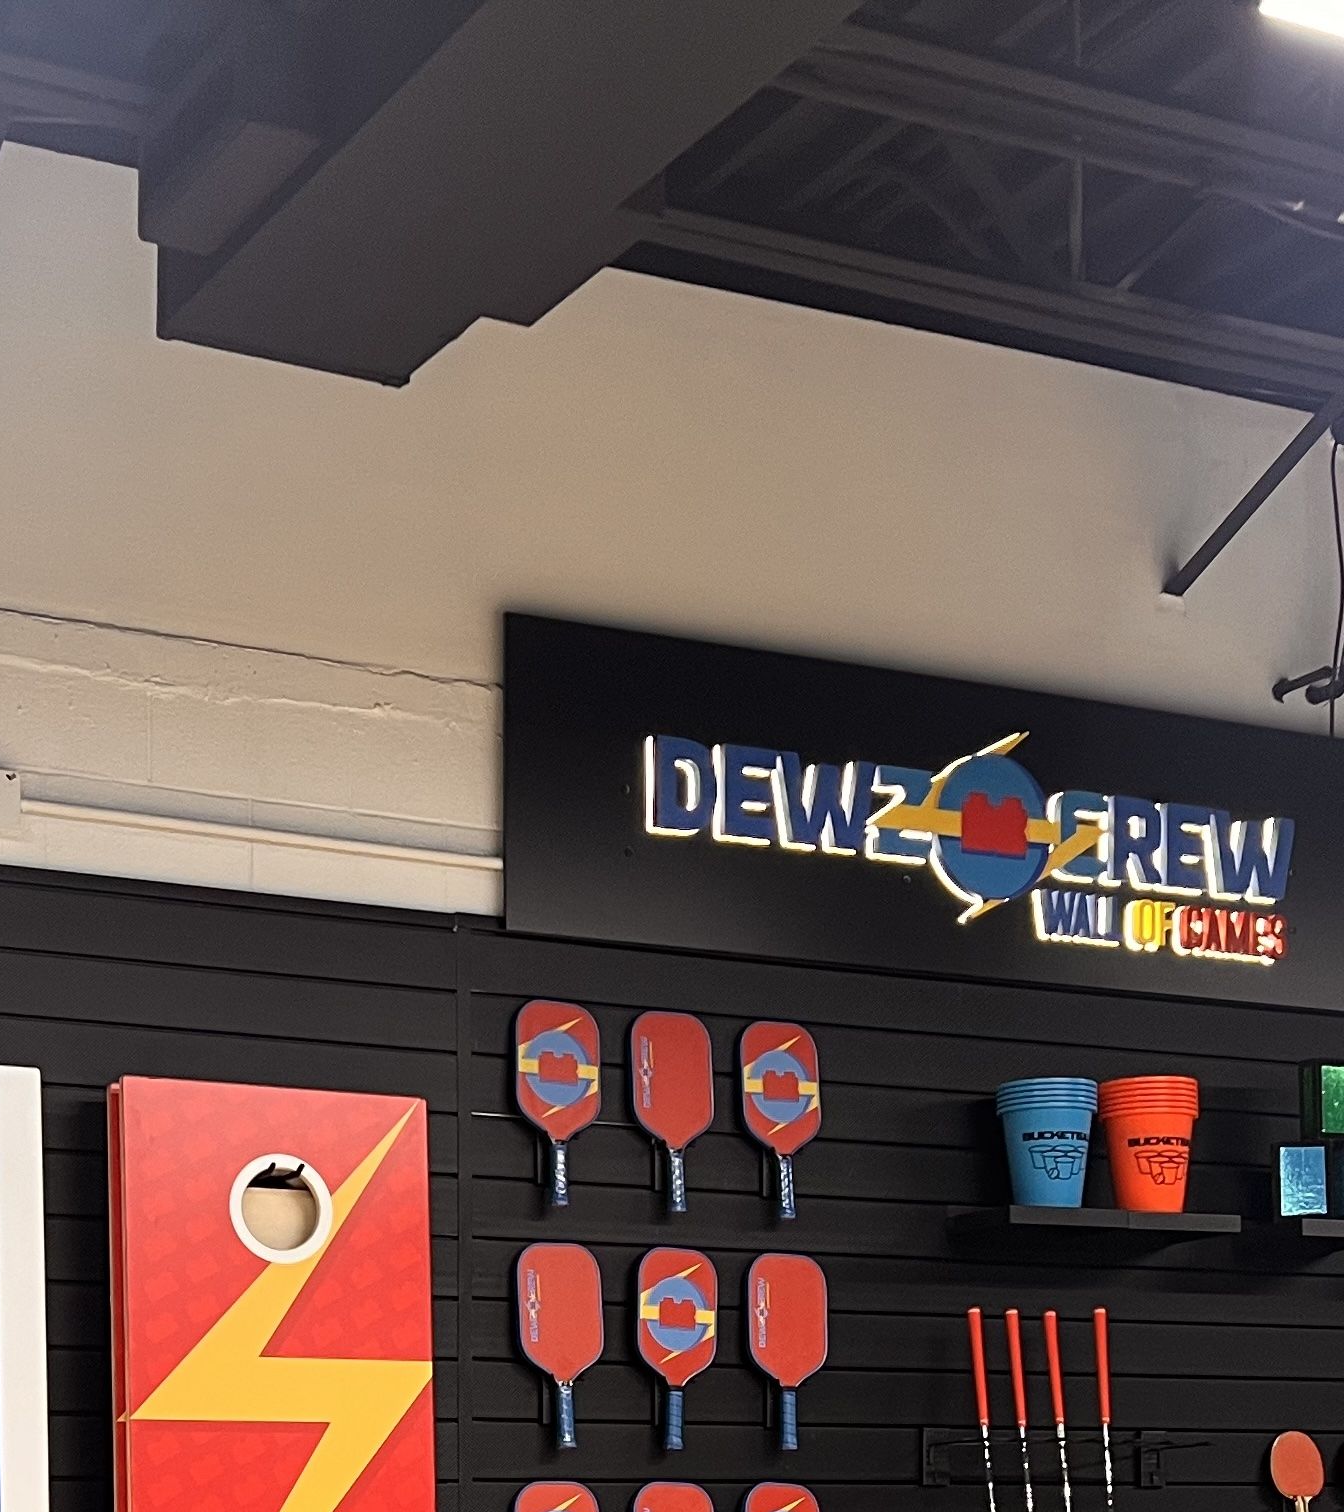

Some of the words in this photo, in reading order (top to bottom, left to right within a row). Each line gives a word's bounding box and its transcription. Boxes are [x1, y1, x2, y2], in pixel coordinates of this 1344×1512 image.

[645, 735, 935, 865] DEWZ
[1046, 790, 1295, 904] CREW
[1032, 888, 1121, 947] WALL
[1123, 899, 1176, 952] OF
[1172, 904, 1288, 966] GAMES
